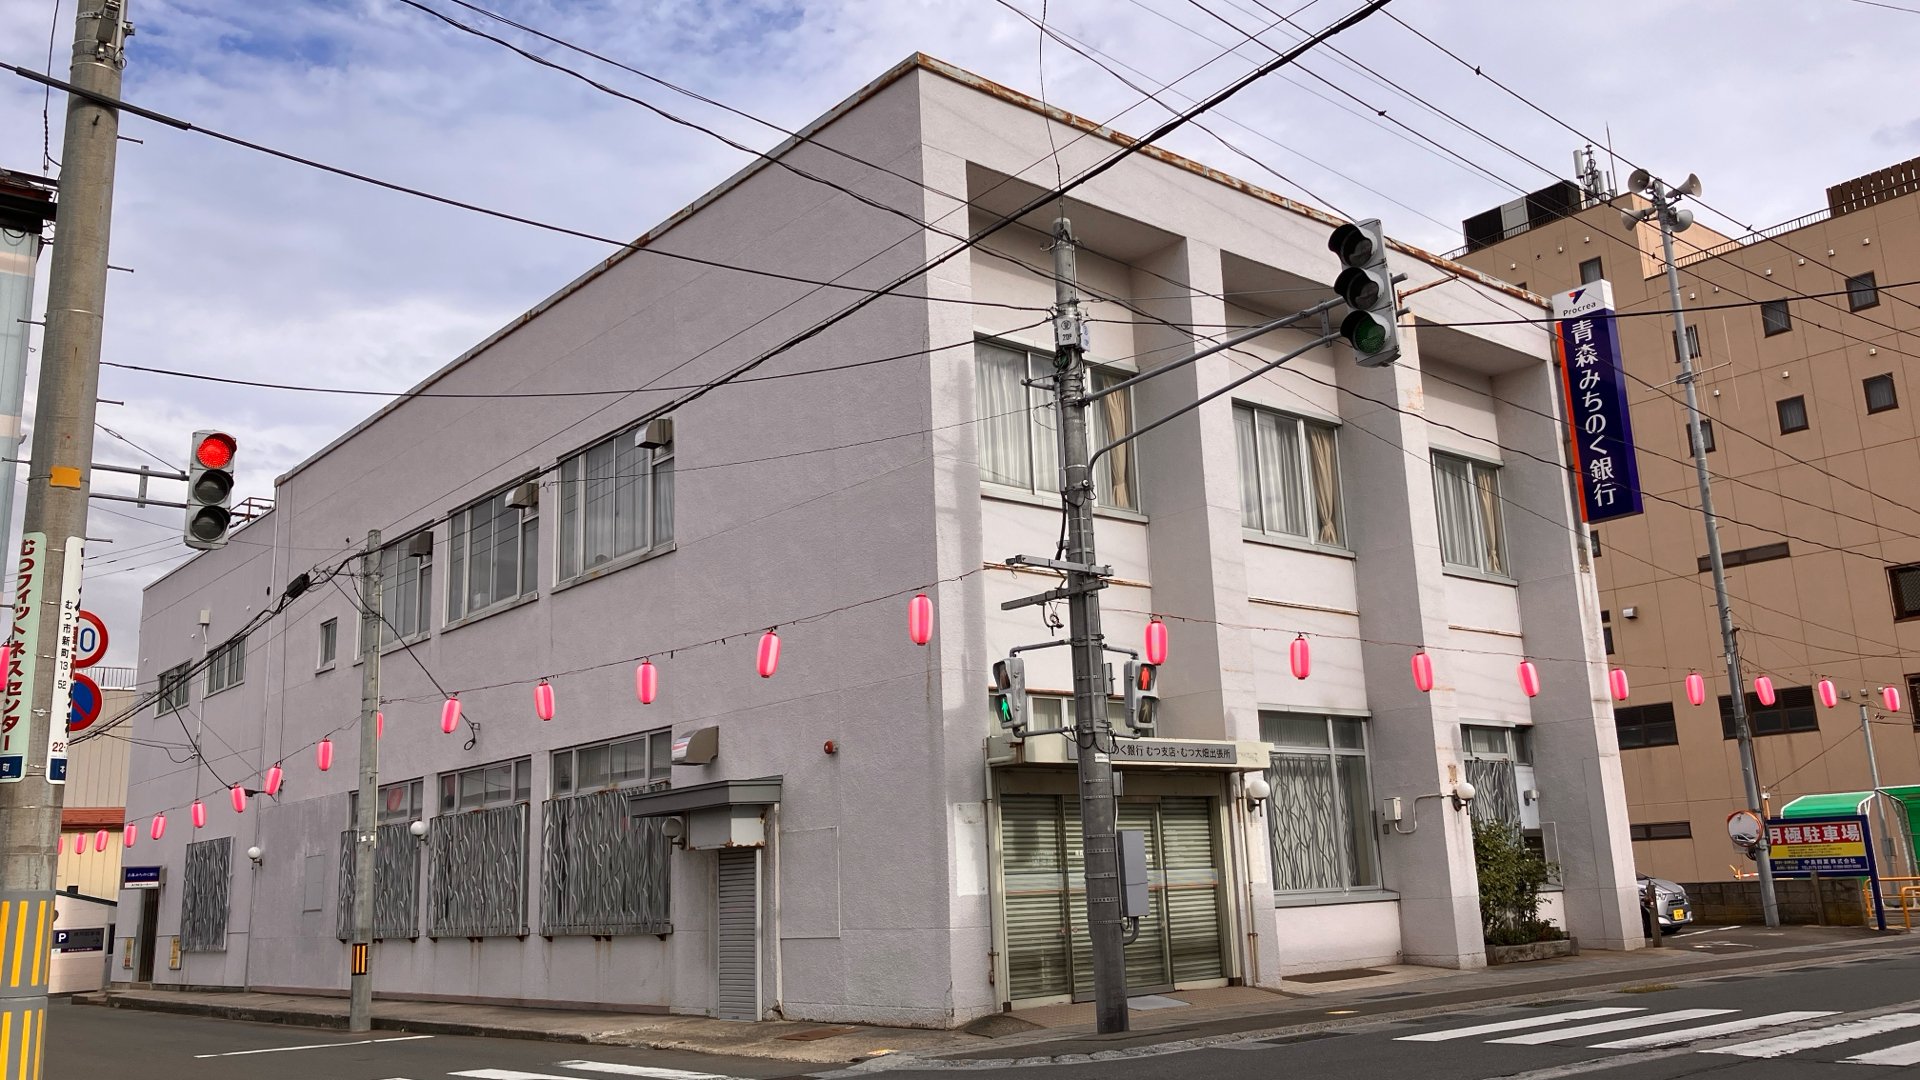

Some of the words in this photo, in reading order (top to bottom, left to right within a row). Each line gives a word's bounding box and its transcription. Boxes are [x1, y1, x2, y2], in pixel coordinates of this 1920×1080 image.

[1563, 302, 1597, 317] Procrea
[1571, 319, 1617, 507] 青森みちのく銀行
[2, 539, 36, 751] むつフィットネスセンター
[80, 627, 96, 652] 0
[1146, 746, 1231, 759] むつ支店・むつ大畑出張所
[1768, 824, 1860, 845] 月極駐車場
[58, 932, 67, 943] P
